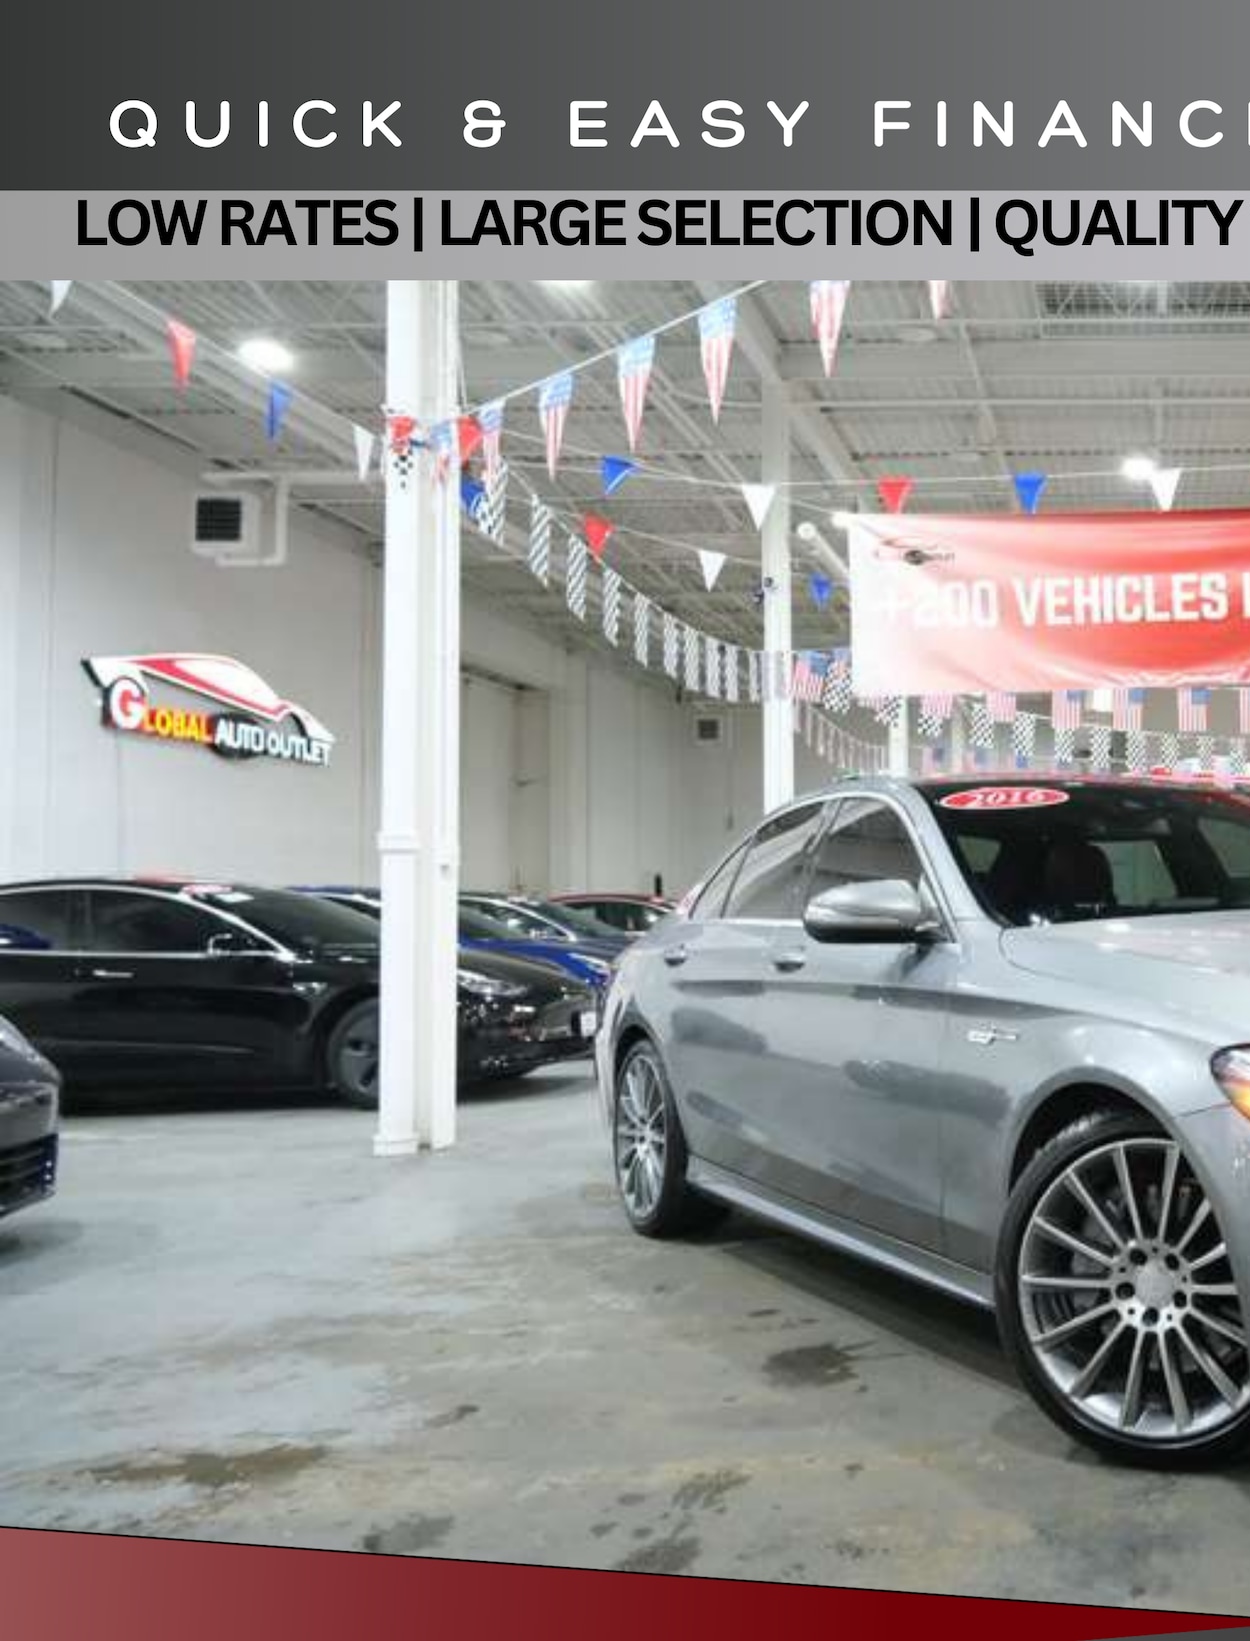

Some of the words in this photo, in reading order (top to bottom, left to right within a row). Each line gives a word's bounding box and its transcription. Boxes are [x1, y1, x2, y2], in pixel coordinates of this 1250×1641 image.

[1010, 571, 1229, 628] VEHICLES
[110, 677, 214, 743] GLOBAL
[214, 718, 264, 752] AUTO
[266, 732, 332, 766] OUTLET
